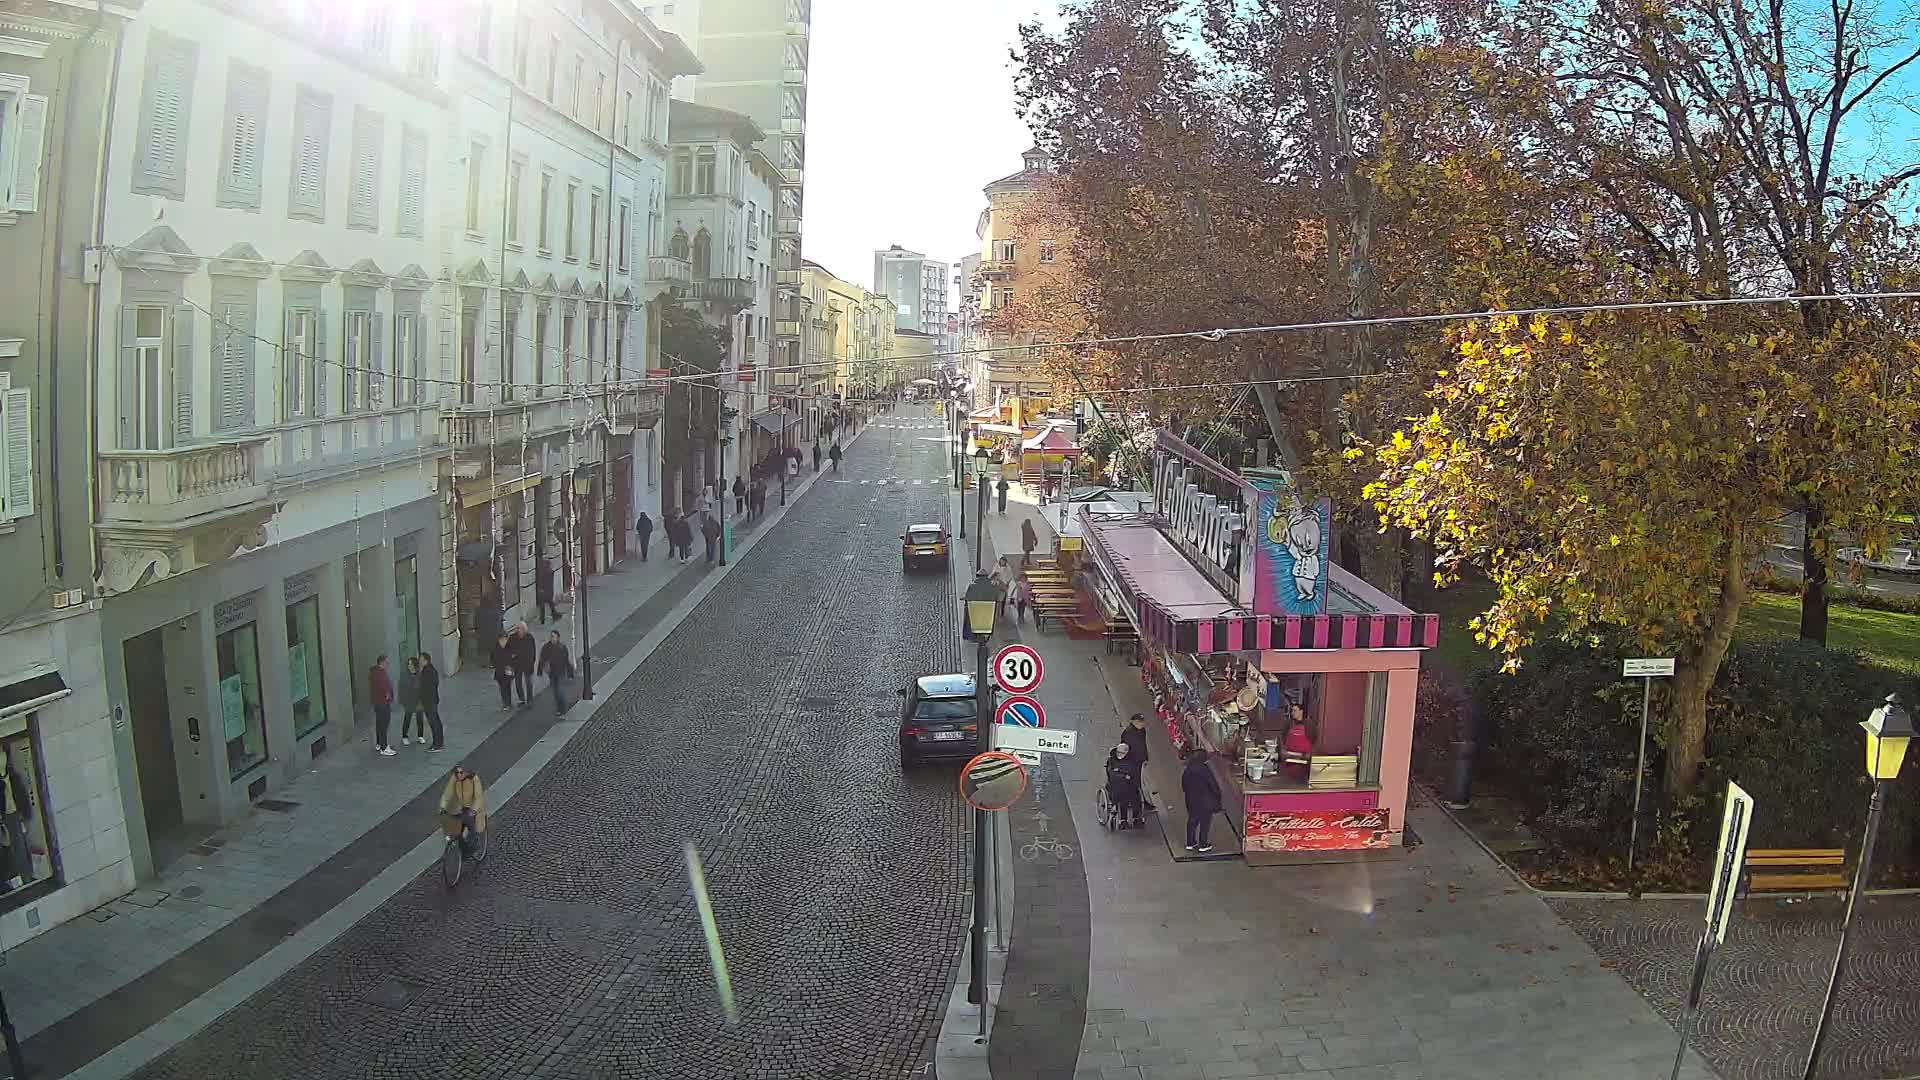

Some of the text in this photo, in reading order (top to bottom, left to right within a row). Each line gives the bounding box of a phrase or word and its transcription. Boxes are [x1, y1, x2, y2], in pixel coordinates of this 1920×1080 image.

[1005, 658, 1033, 681] 30
[1038, 738, 1069, 749] Dante
[1330, 815, 1382, 829] Calde
